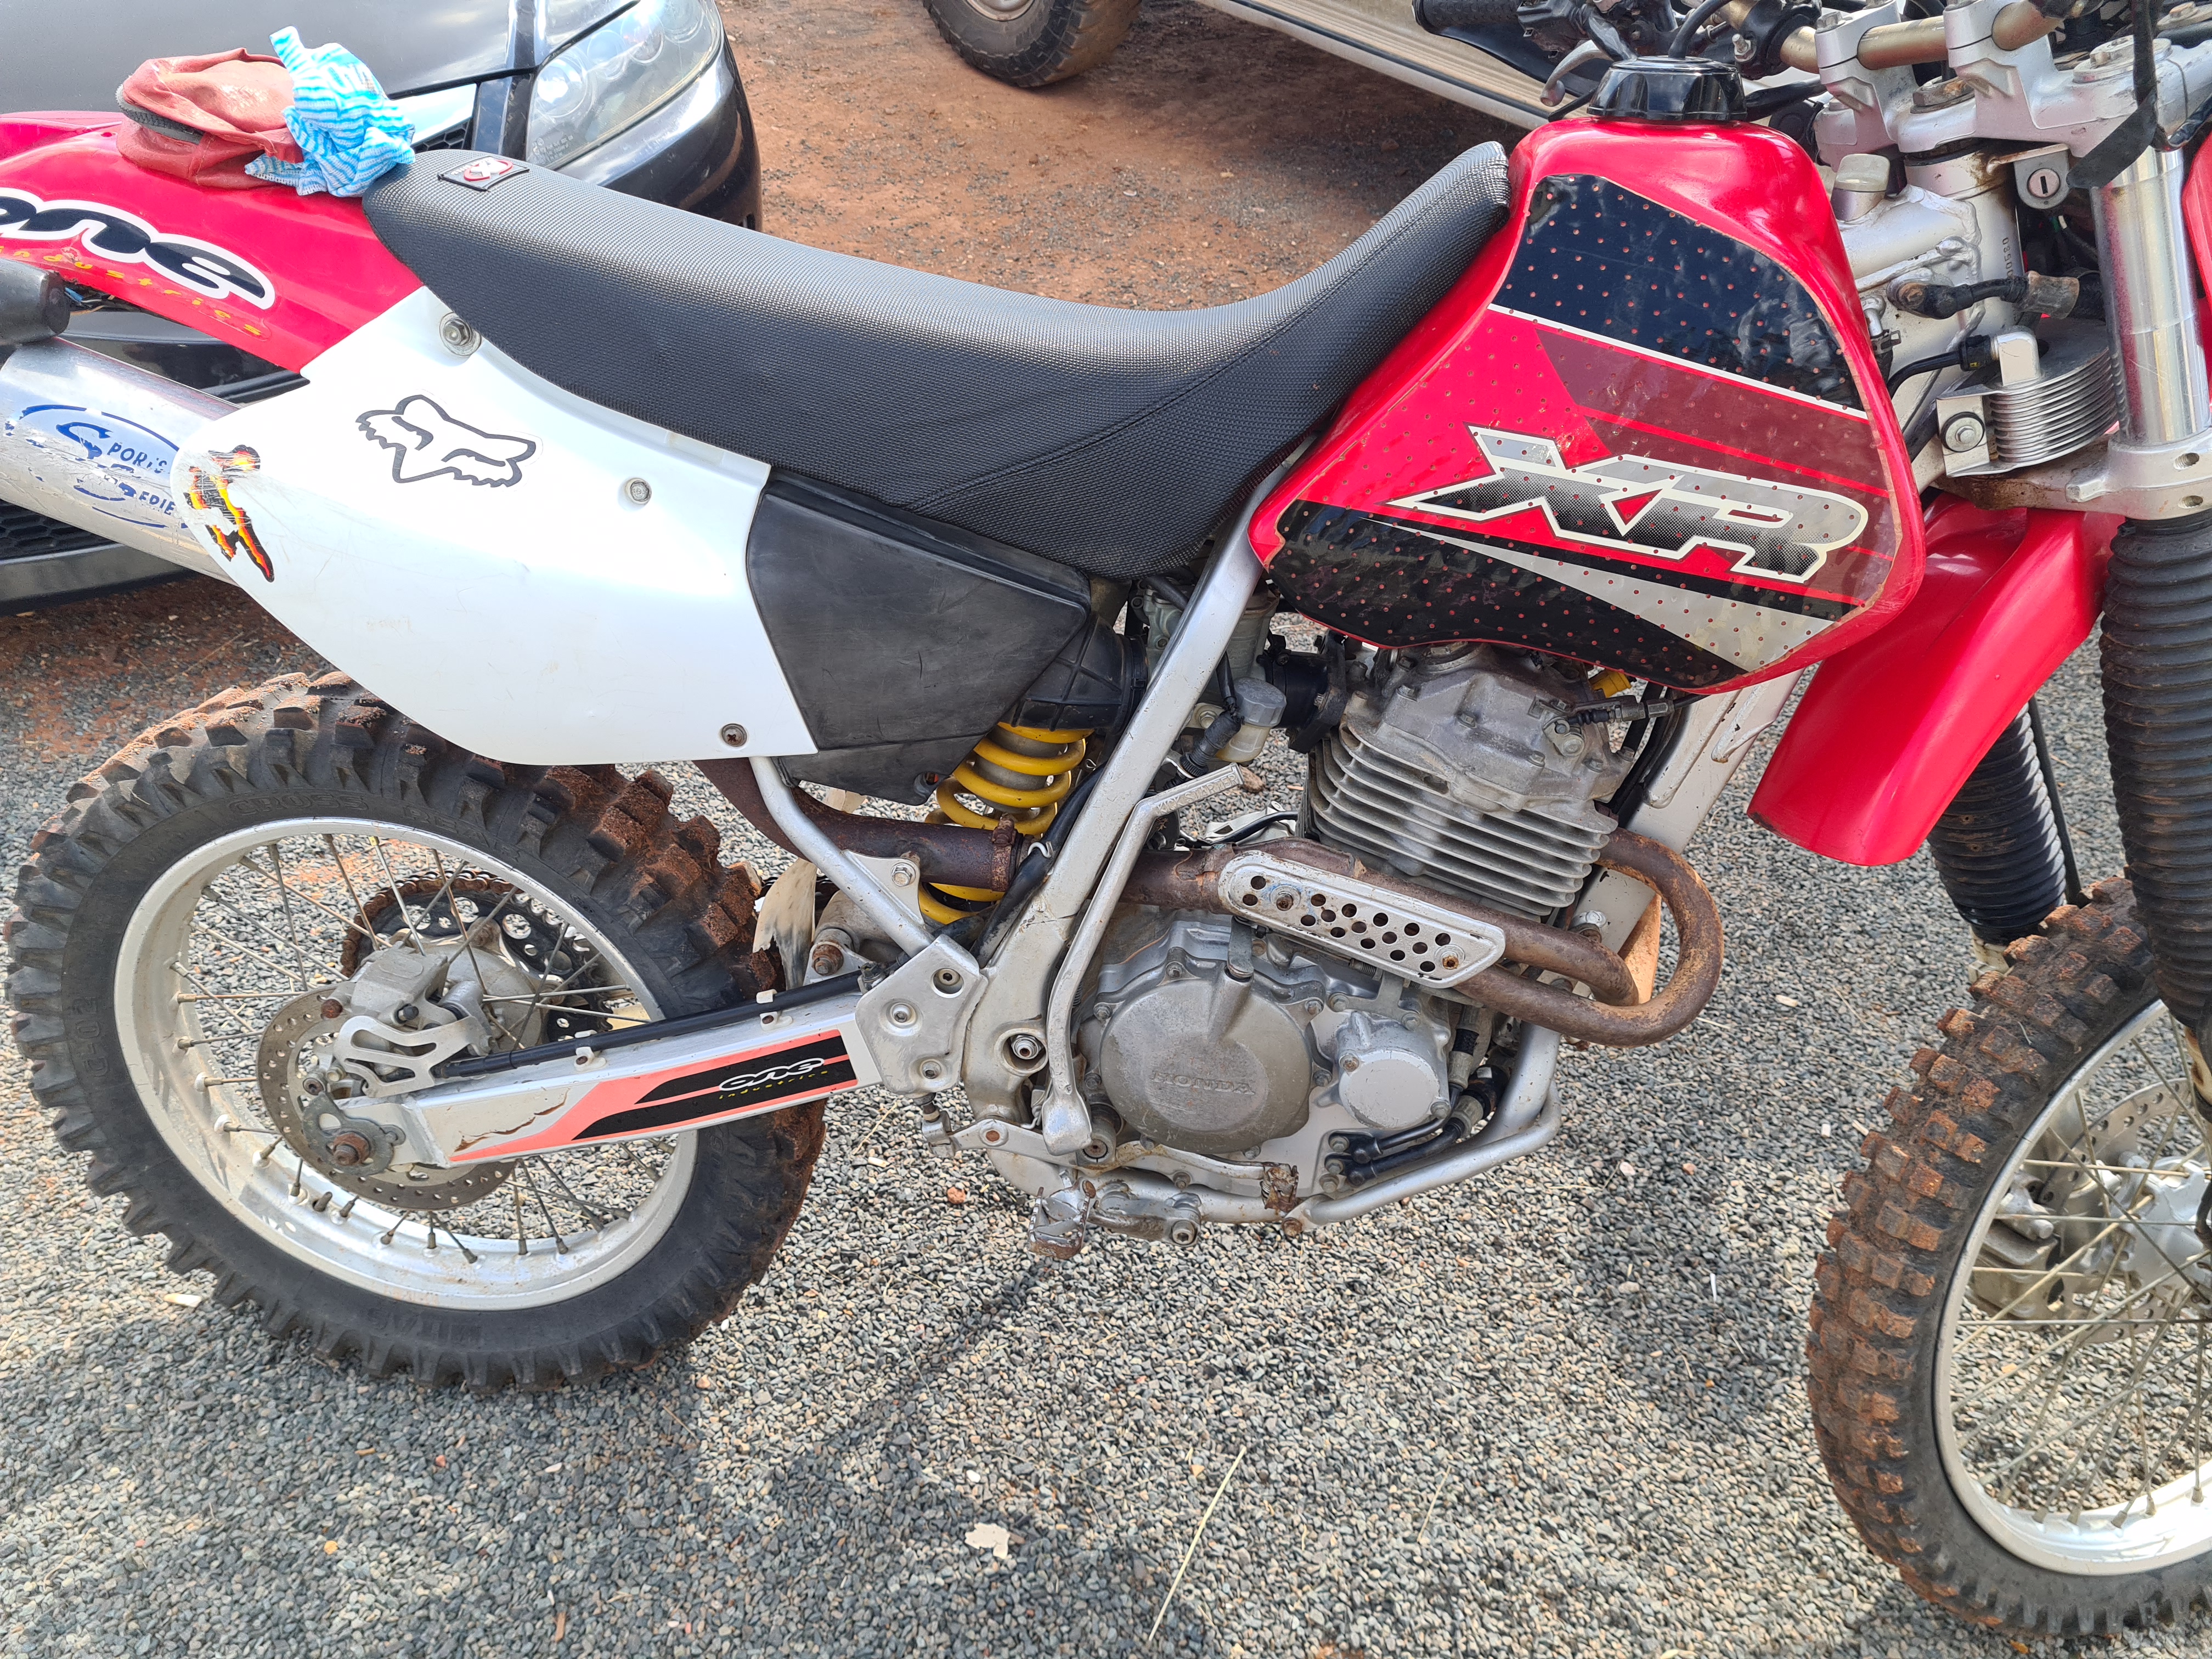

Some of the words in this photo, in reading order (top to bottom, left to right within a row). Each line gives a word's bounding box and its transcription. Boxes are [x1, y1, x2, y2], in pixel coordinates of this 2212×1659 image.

[1385, 422, 1869, 585] XR
[228, 794, 369, 816] CROSS
[1156, 795, 1184, 815] KICK
[1184, 773, 1239, 803] STARTER
[718, 1057, 825, 1091] one
[719, 1070, 828, 1100] industries
[1150, 1070, 1256, 1095] HONDA
